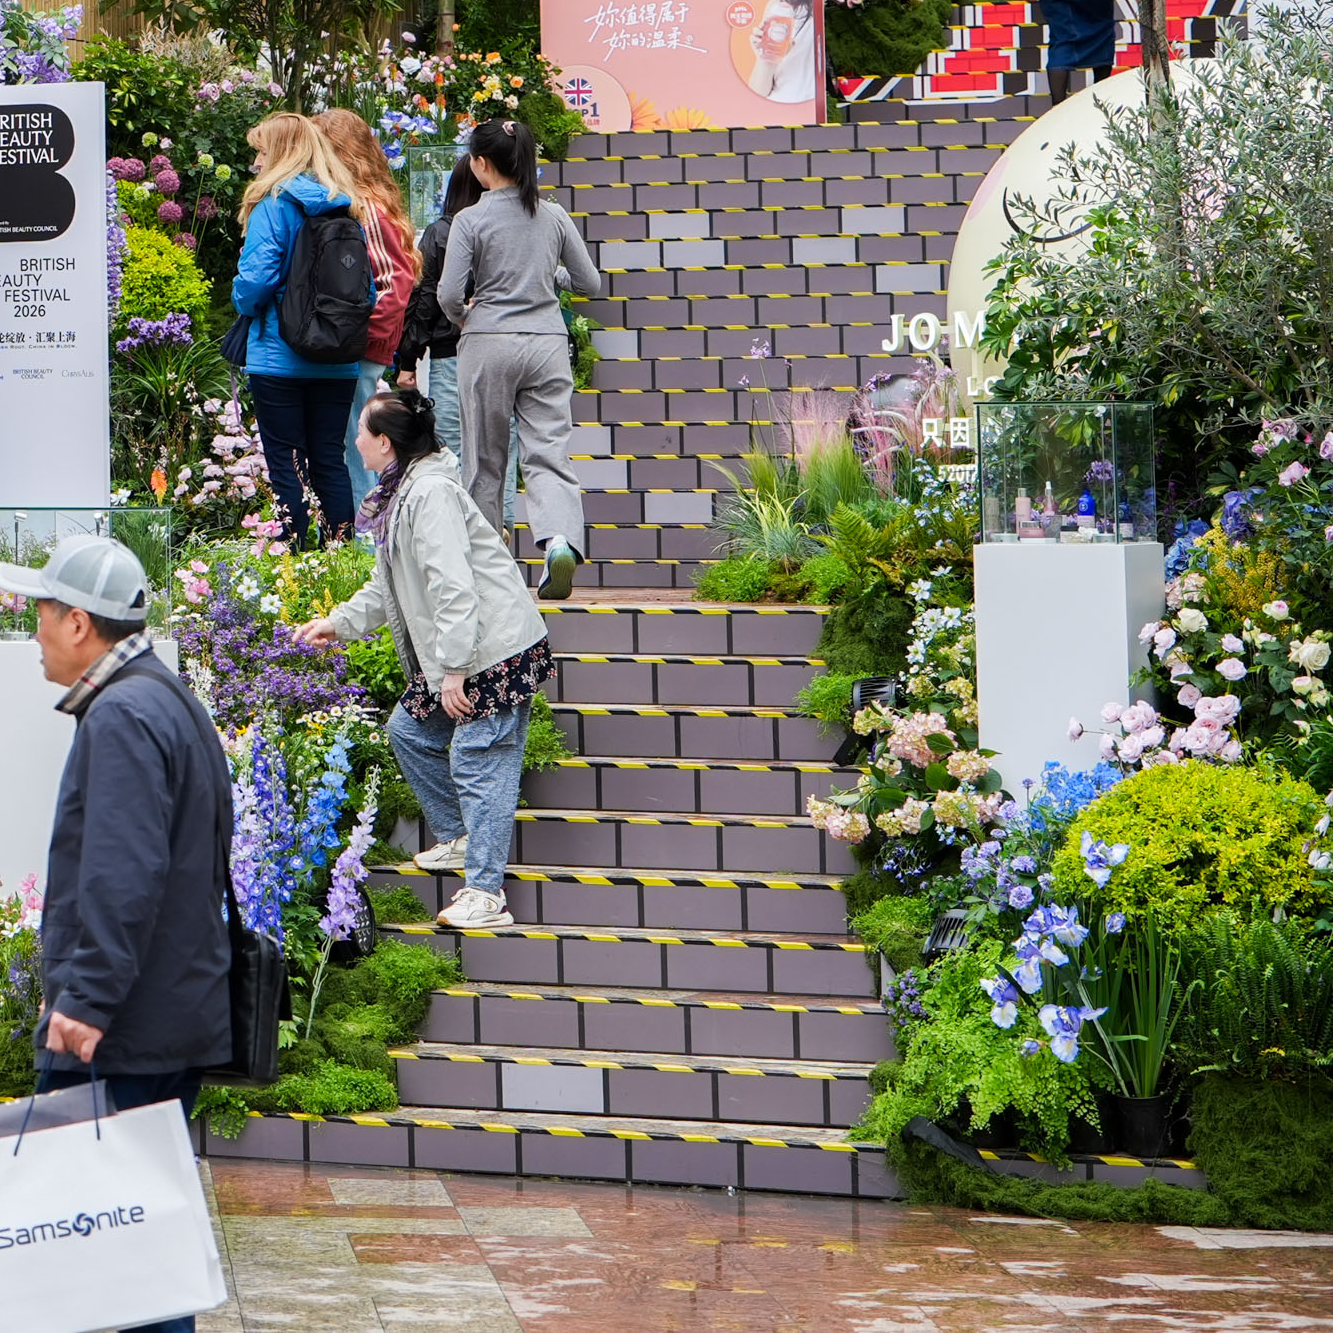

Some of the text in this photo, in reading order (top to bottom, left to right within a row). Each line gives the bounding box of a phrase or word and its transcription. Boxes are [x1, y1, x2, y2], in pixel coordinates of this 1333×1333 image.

[20, 258, 75, 271] BRITISH
[4, 289, 71, 302] FESTIVAL
[14, 304, 46, 317] 2026
[882, 312, 944, 353] JO
